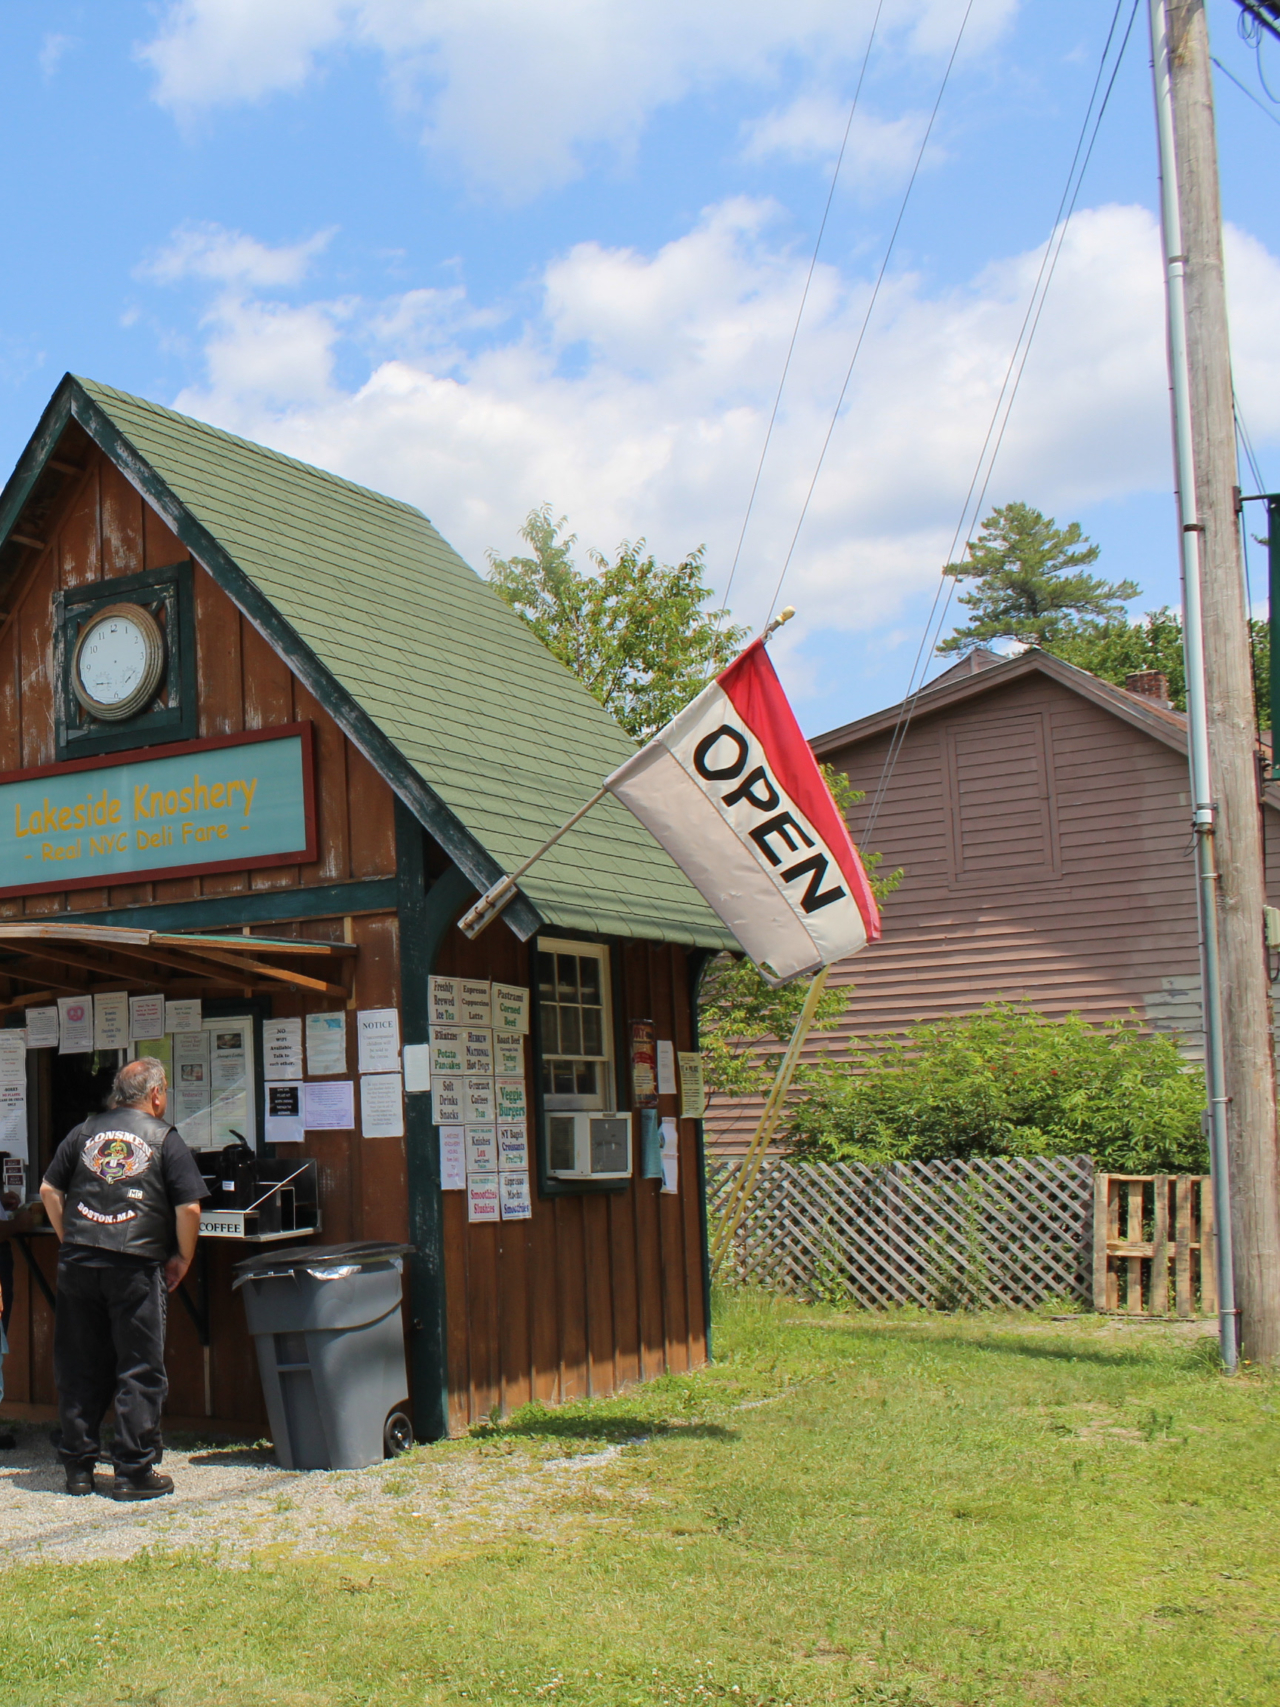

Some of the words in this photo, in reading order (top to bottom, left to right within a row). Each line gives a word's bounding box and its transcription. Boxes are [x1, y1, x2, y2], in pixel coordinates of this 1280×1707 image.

[90, 645, 98, 654] 10
[14, 789, 123, 837] Lakeside
[133, 774, 258, 821] Knoshery
[692, 723, 847, 915] OPEN
[41, 838, 82, 862] Real
[89, 832, 127, 856] NYC
[136, 825, 173, 850] Deli
[182, 821, 229, 845] Fare
[434, 980, 454, 995] Freshly
[463, 985, 487, 996] Espresso
[433, 994, 455, 1006] Brewed
[497, 989, 523, 1002] Pastrami
[436, 1008, 444, 1020] Ice
[445, 1010, 454, 1020] Tea
[500, 1002, 521, 1015] Corned
[468, 1011, 483, 1020] Latte
[362, 1020, 393, 1030] NOTICE
[504, 1016, 517, 1027] Beef
[497, 1035, 510, 1044] Roast
[510, 1035, 521, 1045] Beef
[437, 1048, 456, 1058] Potato
[503, 1053, 517, 1063] Turkey
[434, 1059, 461, 1069] Pancakes
[466, 1059, 477, 1070] Hot
[477, 1060, 490, 1073] Dogs
[442, 1081, 454, 1091] Soft
[468, 1080, 490, 1090] Gourmet
[439, 1094, 458, 1106] Drinks
[500, 1087, 523, 1104] Veggie
[439, 1109, 459, 1120] Snacks
[475, 1108, 486, 1118] Teas
[498, 1103, 525, 1120] Burgers
[501, 1129, 509, 1139] NY
[510, 1129, 523, 1141] Bagels
[472, 1136, 491, 1146] Knishes
[502, 1142, 525, 1151] Croissants
[476, 1148, 486, 1157] Lox
[503, 1176, 524, 1187] Espresso
[130, 1190, 143, 1198] MC
[470, 1189, 497, 1200] Smoothies
[474, 1203, 495, 1214] Slushies
[504, 1203, 529, 1214] Smoothies
[199, 1222, 241, 1233] COFFEE
